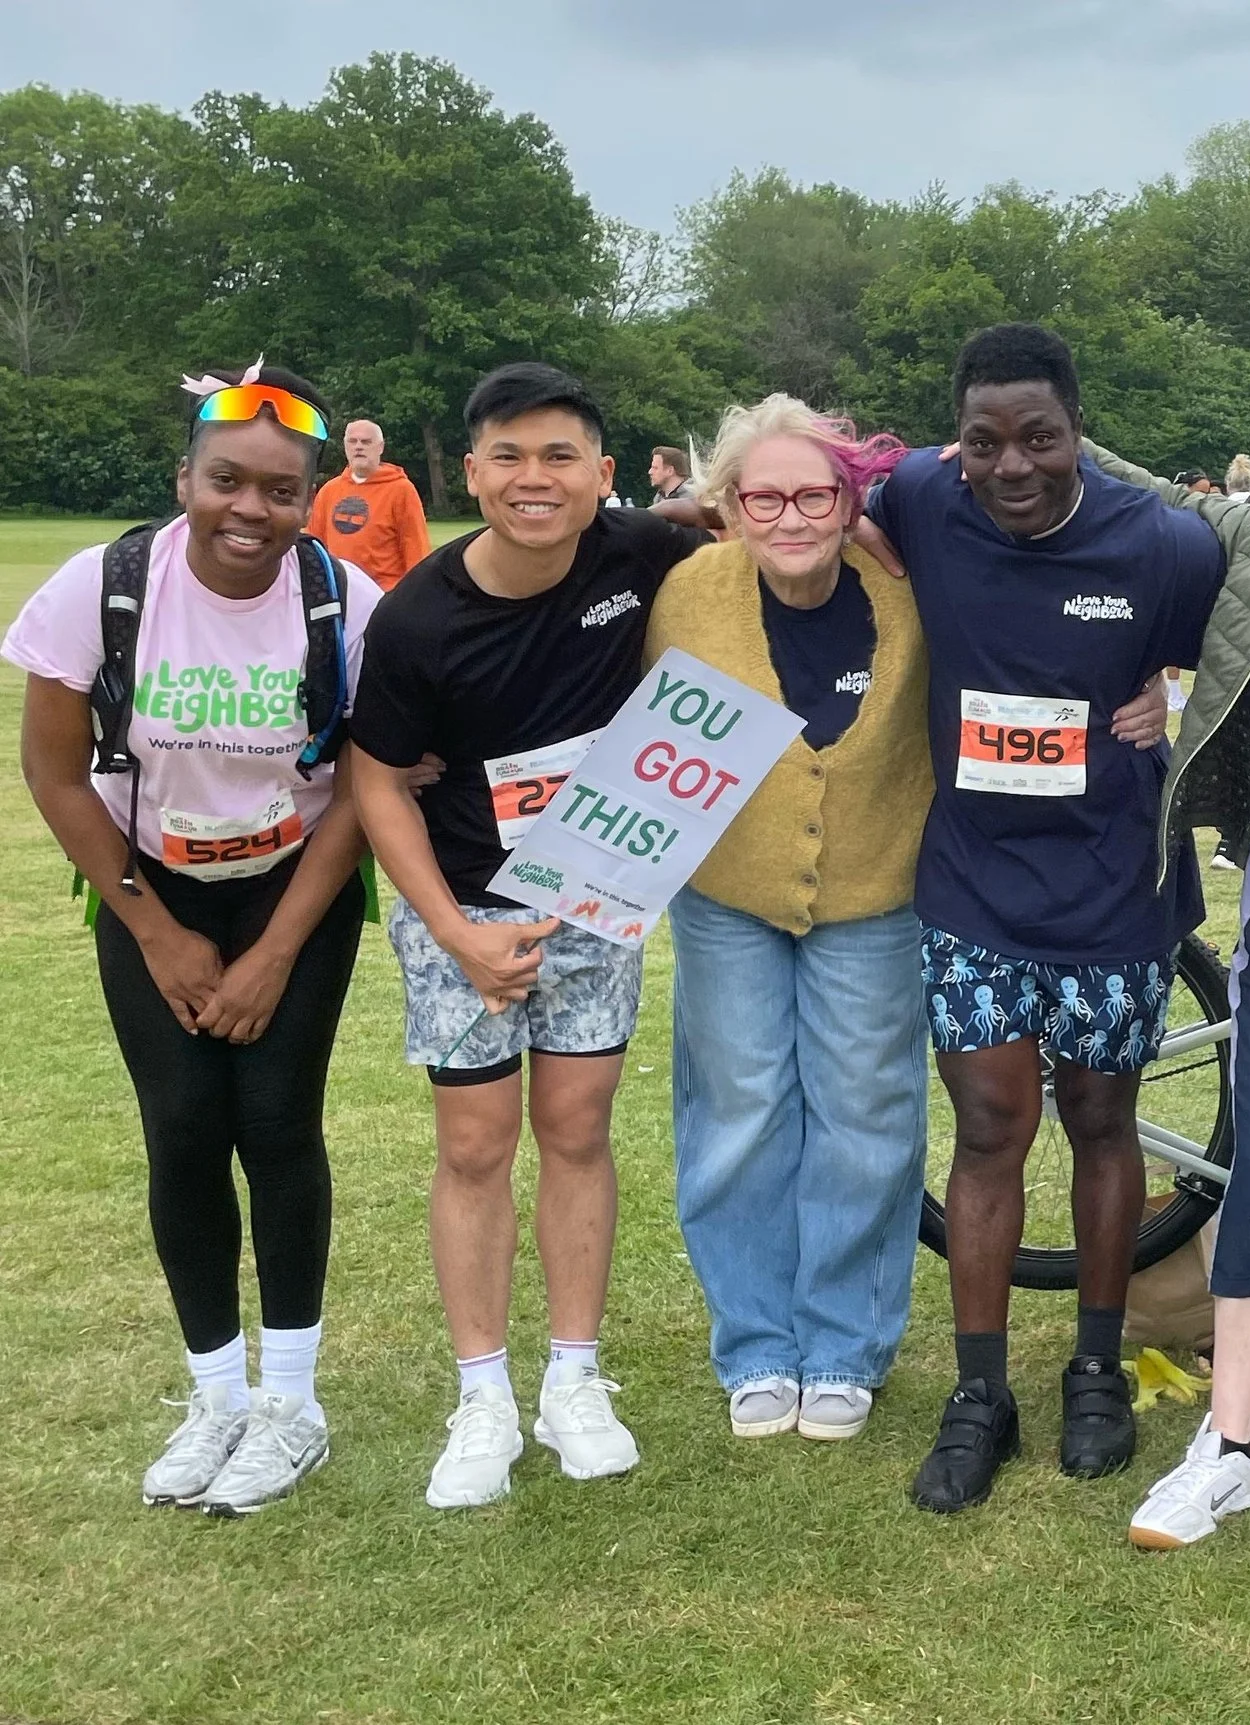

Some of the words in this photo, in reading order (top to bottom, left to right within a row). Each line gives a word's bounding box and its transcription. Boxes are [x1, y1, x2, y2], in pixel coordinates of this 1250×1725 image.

[647, 671, 743, 741] YOU
[148, 737, 194, 750] We're
[198, 739, 211, 749] in
[216, 742, 244, 753] this
[979, 725, 1065, 764] 496
[633, 741, 740, 811] GOT
[186, 826, 281, 864] 524
[559, 784, 679, 864] THIS!
